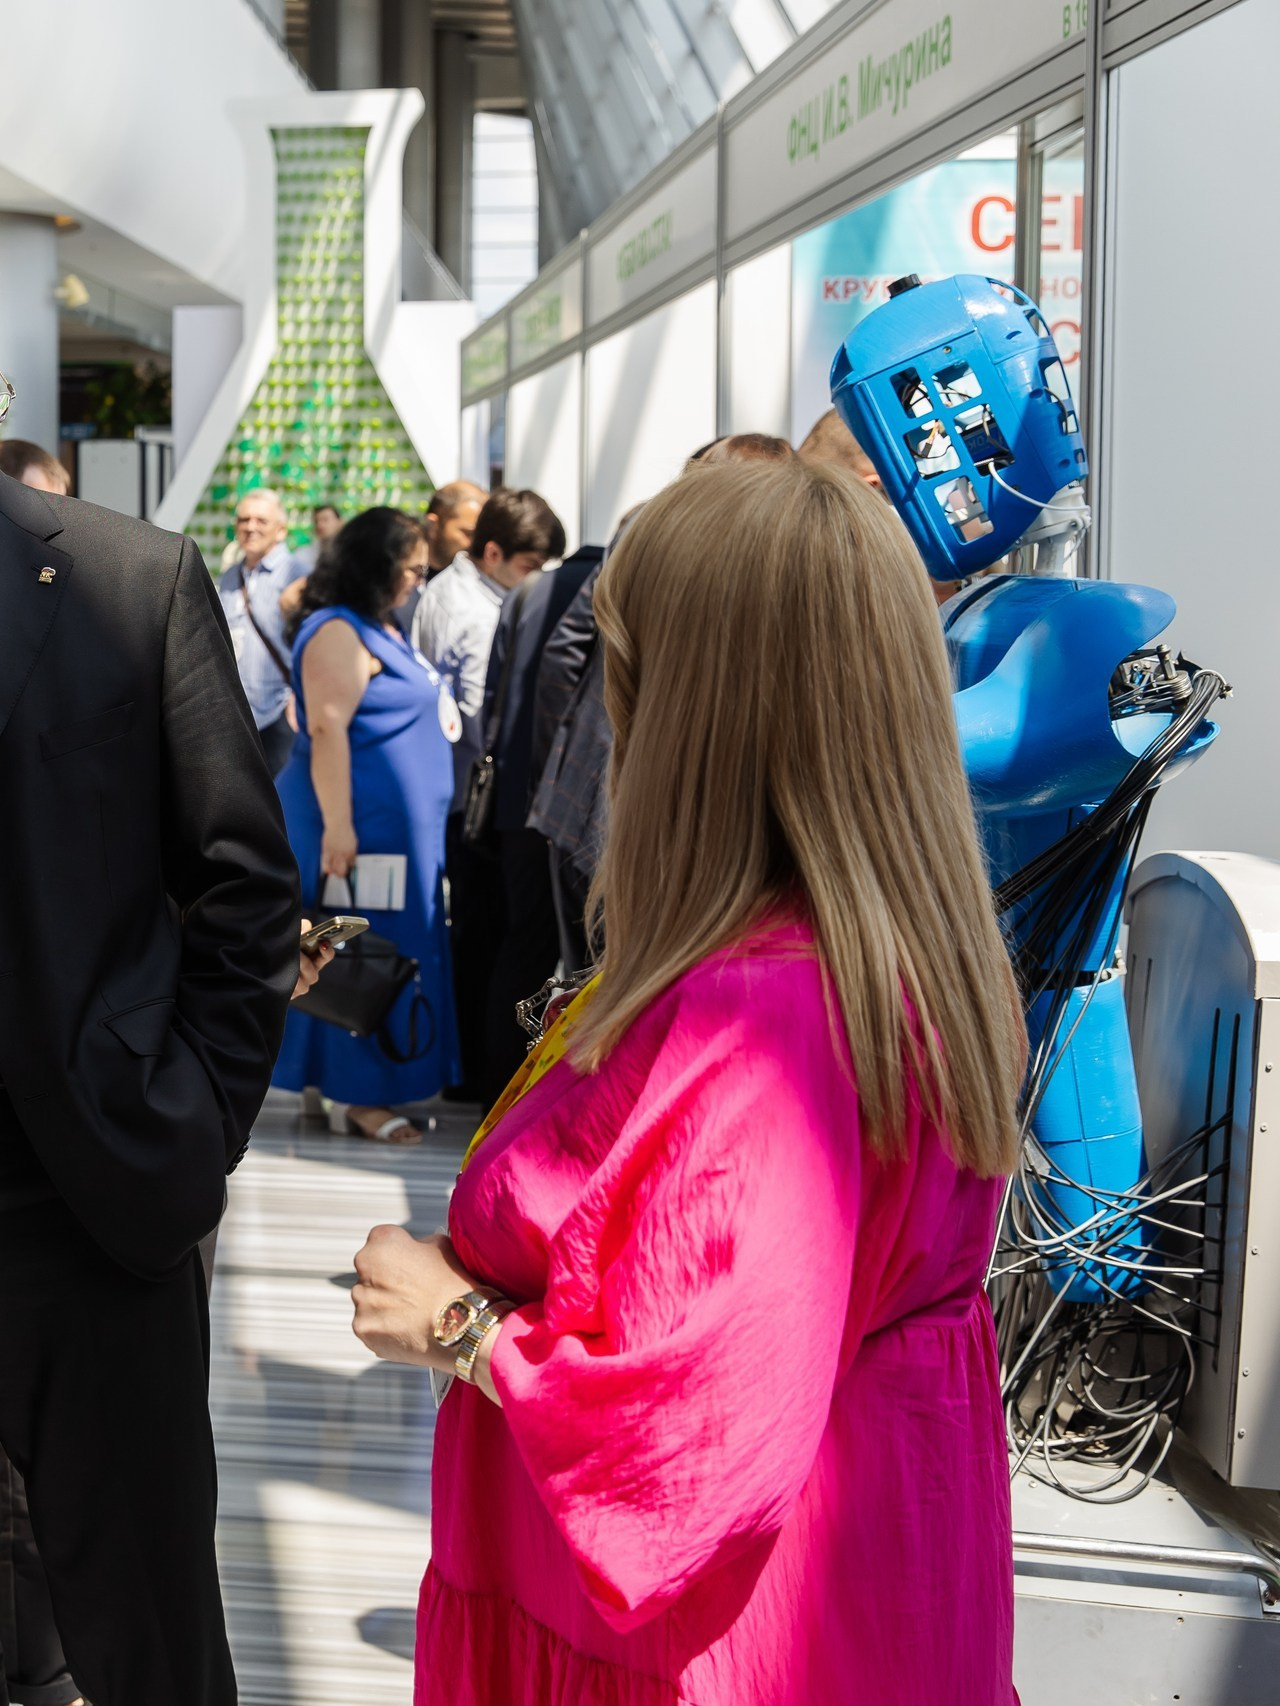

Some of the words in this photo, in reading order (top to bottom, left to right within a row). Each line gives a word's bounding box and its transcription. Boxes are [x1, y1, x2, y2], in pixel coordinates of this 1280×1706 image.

[787, 97, 820, 165] ФНЦ
[823, 74, 854, 144] И.В.
[858, 15, 952, 122] Мичурина
